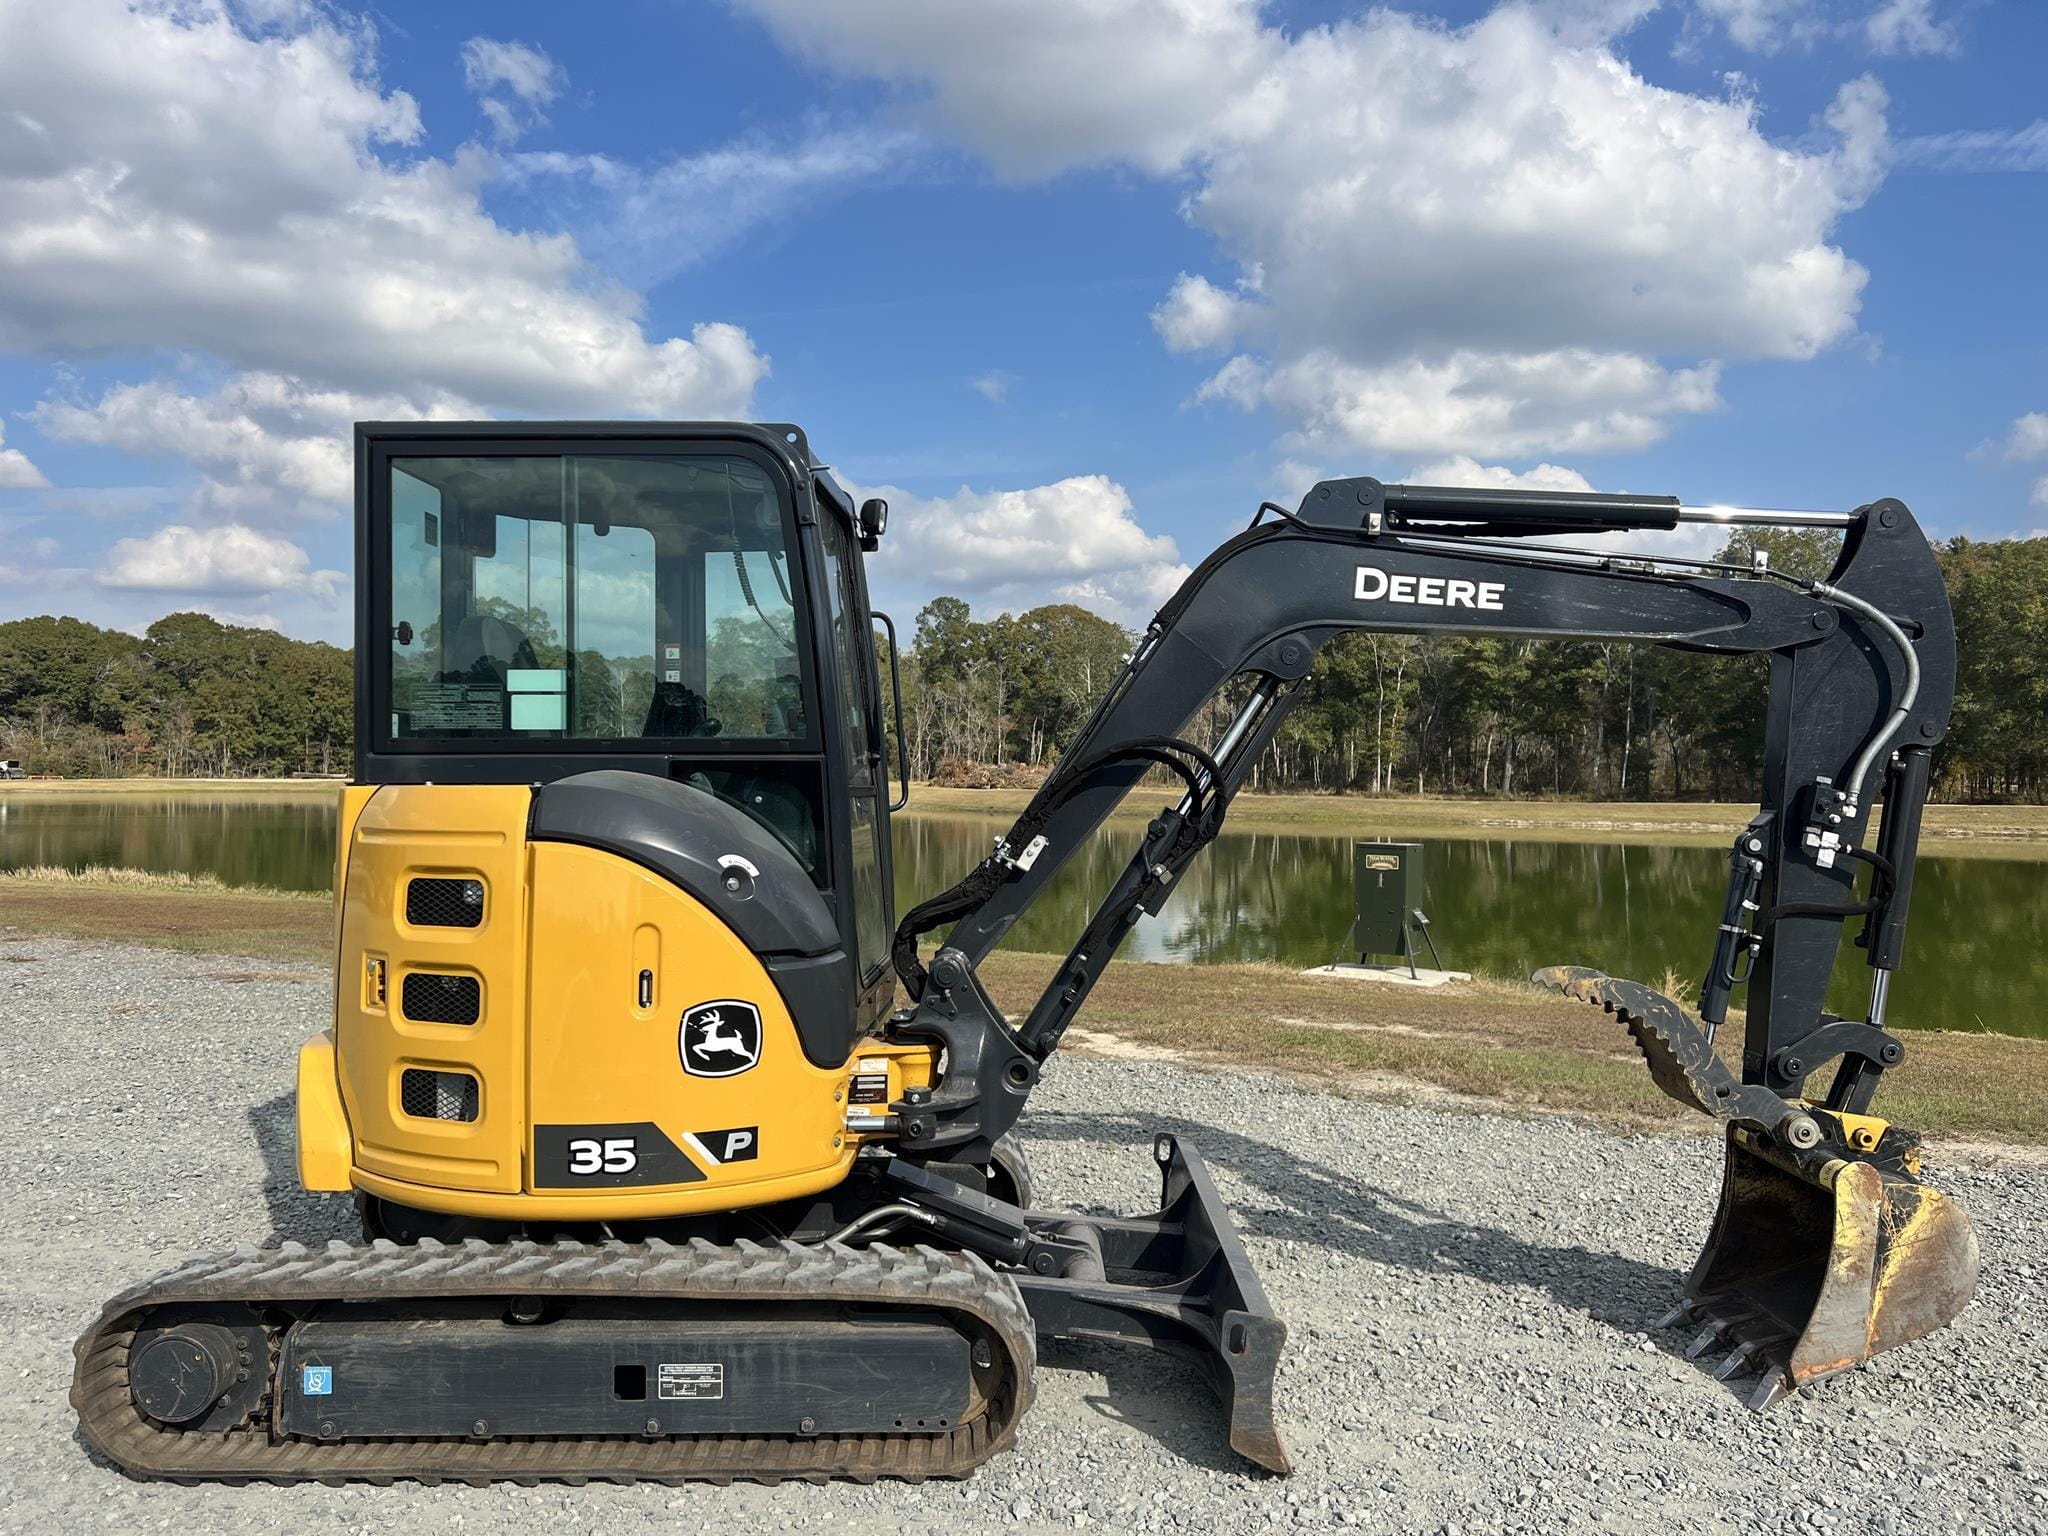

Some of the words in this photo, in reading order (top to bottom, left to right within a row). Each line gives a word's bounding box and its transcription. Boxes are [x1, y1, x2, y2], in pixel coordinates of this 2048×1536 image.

[1354, 566, 1506, 611] DEERE
[570, 1139, 636, 1174] 35
[724, 1131, 753, 1160] P
